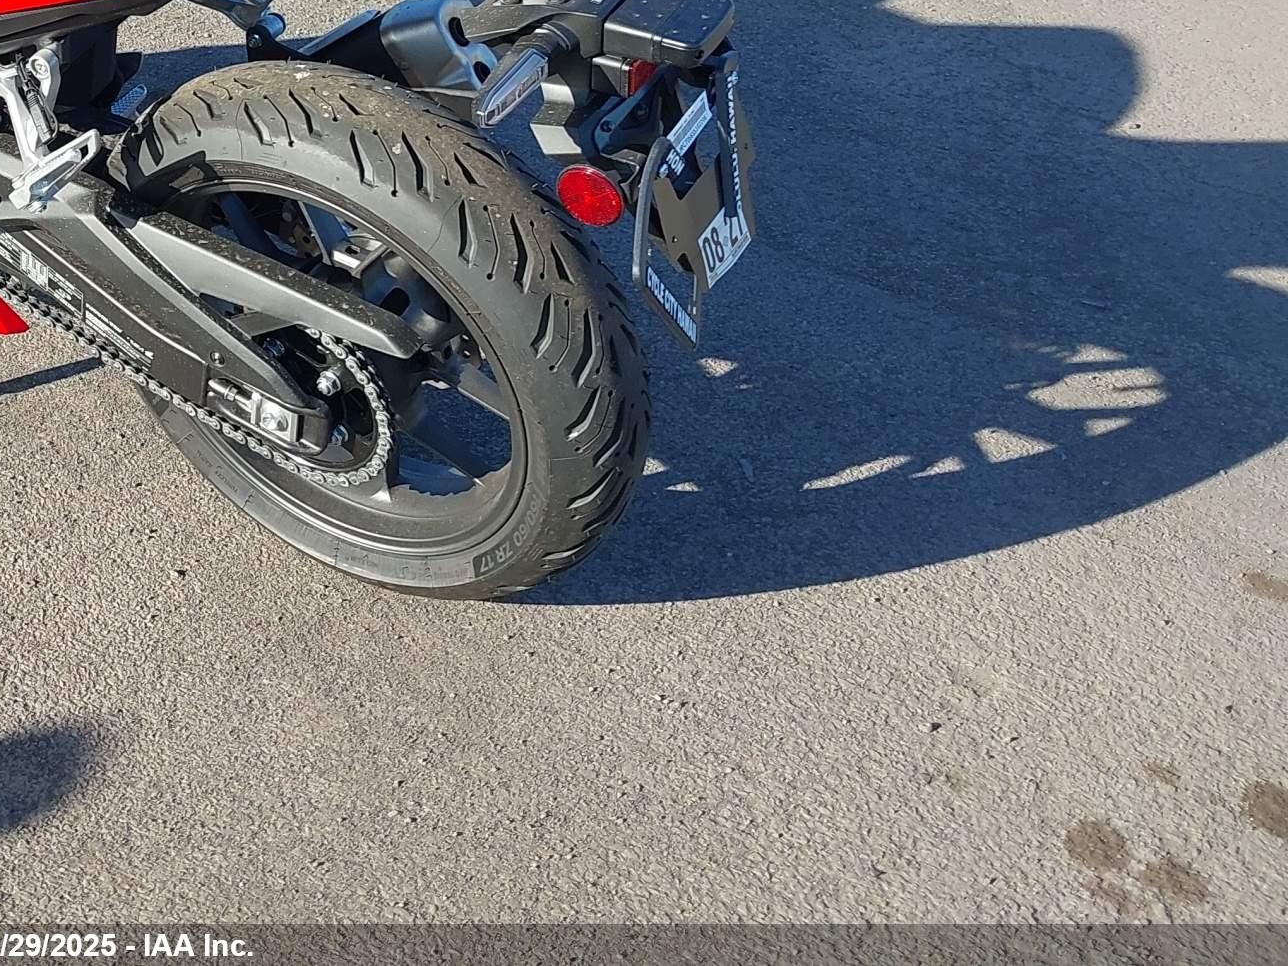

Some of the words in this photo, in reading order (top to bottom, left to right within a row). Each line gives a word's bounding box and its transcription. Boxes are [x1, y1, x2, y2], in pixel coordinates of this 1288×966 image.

[702, 225, 726, 274] 08
[647, 265, 665, 305] CYCLE
[664, 288, 679, 321] CITY
[480, 555, 495, 573] 17
[494, 539, 513, 564] ZR
